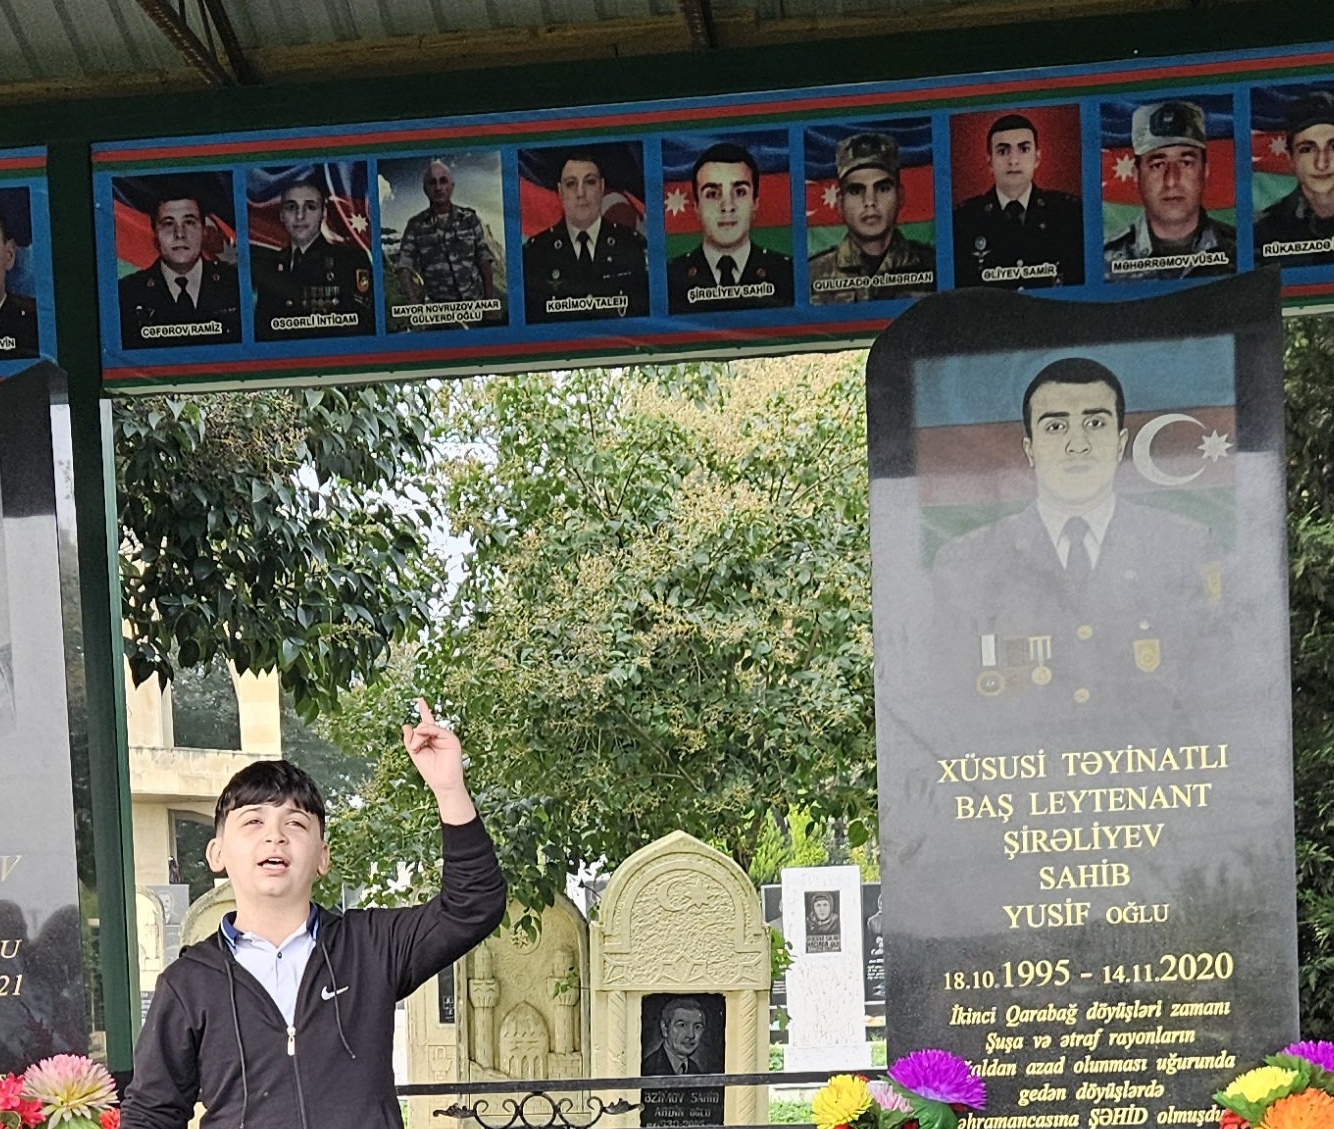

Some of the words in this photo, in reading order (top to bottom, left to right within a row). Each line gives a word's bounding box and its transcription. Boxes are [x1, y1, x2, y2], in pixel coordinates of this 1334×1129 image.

[983, 267, 1020, 281] ƏLİYEV
[1114, 257, 1190, 271] MƏHƏRRƏMOV
[548, 298, 594, 311] KƏRİMOV
[689, 287, 740, 302] ŞİRƏLİYEV
[394, 306, 423, 315] MAYOR
[426, 303, 473, 313] NOVRUZOV
[475, 301, 499, 310] ANAR
[457, 311, 482, 321] OĞLU
[273, 317, 315, 328] ƏSGƏRLİ
[937, 749, 1047, 783] XÜSUSİ
[1062, 744, 1228, 777] TƏYİNATLI
[955, 793, 1014, 823] BAŞ
[1030, 783, 1212, 816] LEYTENANT
[1003, 821, 1165, 860] ŞİRƏLİYEV
[1039, 859, 1130, 890] SAHİB
[1003, 898, 1091, 929] YUSİF
[1106, 902, 1170, 924] OĞLU
[944, 959, 1070, 990] 18.10.1995
[1103, 952, 1234, 984] 14.11.2020
[949, 1003, 997, 1025] İkinci
[1005, 1003, 1078, 1027] Qarabağ
[1086, 1000, 1162, 1023] döyüşləri
[1170, 1001, 1230, 1016] zamanı
[985, 1032, 1023, 1054] Şuşa
[1033, 1036, 1052, 1048] və
[1060, 1028, 1104, 1051] ətraf
[1108, 1026, 1196, 1049] rayonların
[1025, 1056, 1064, 1074] azad
[1073, 1054, 1147, 1073] olunması
[1156, 1051, 1236, 1074] uğurunda
[1018, 1083, 1066, 1106] gedən
[1076, 1080, 1164, 1103] döyüşlərdə
[1089, 1103, 1148, 1129] ŞƏHİD
